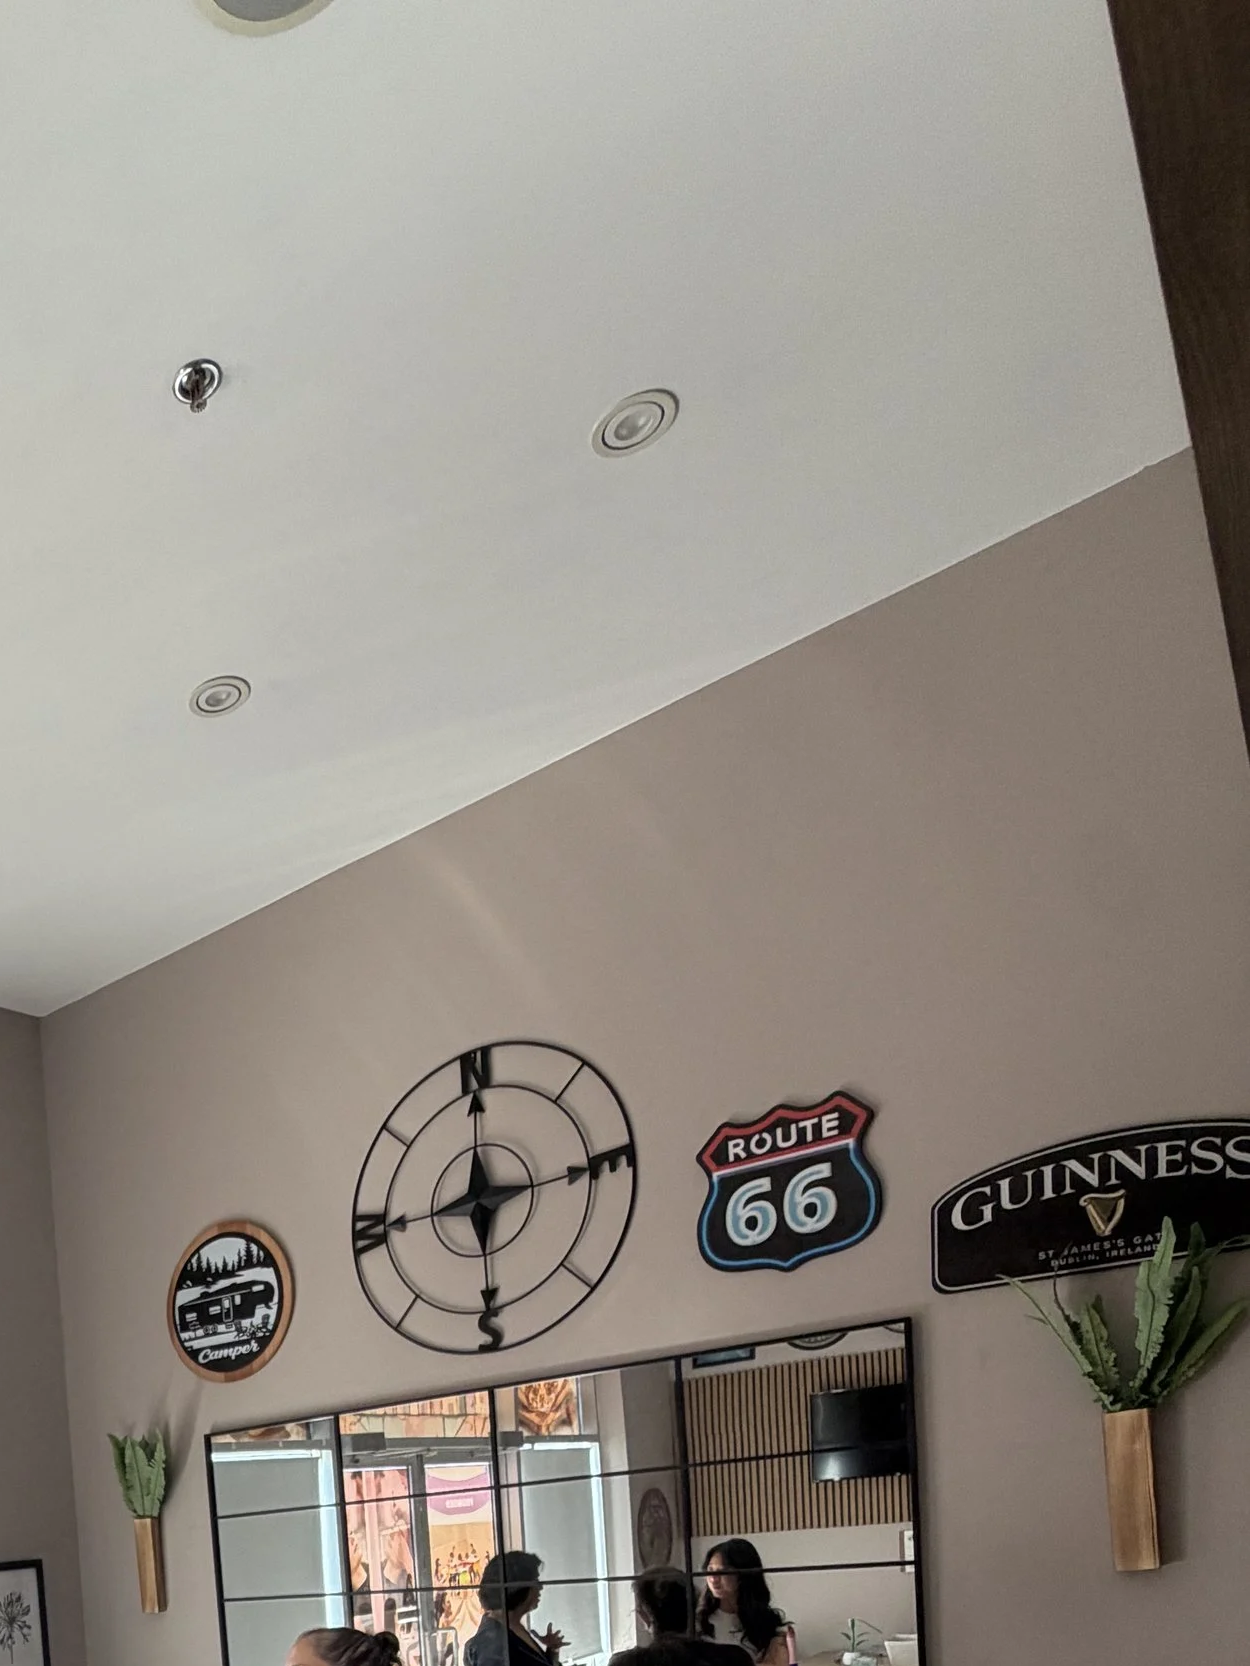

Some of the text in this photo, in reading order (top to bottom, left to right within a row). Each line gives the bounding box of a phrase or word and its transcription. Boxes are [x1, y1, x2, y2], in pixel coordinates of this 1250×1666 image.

[460, 1045, 491, 1095] N
[726, 1111, 841, 1163] ROUTE
[588, 1143, 635, 1181] E
[950, 1134, 1250, 1231] GUINNESS
[724, 1162, 839, 1247] 66
[354, 1213, 388, 1256] W
[1038, 1249, 1055, 1260] ST
[197, 1339, 261, 1364] Camper
[477, 1310, 505, 1352] S
